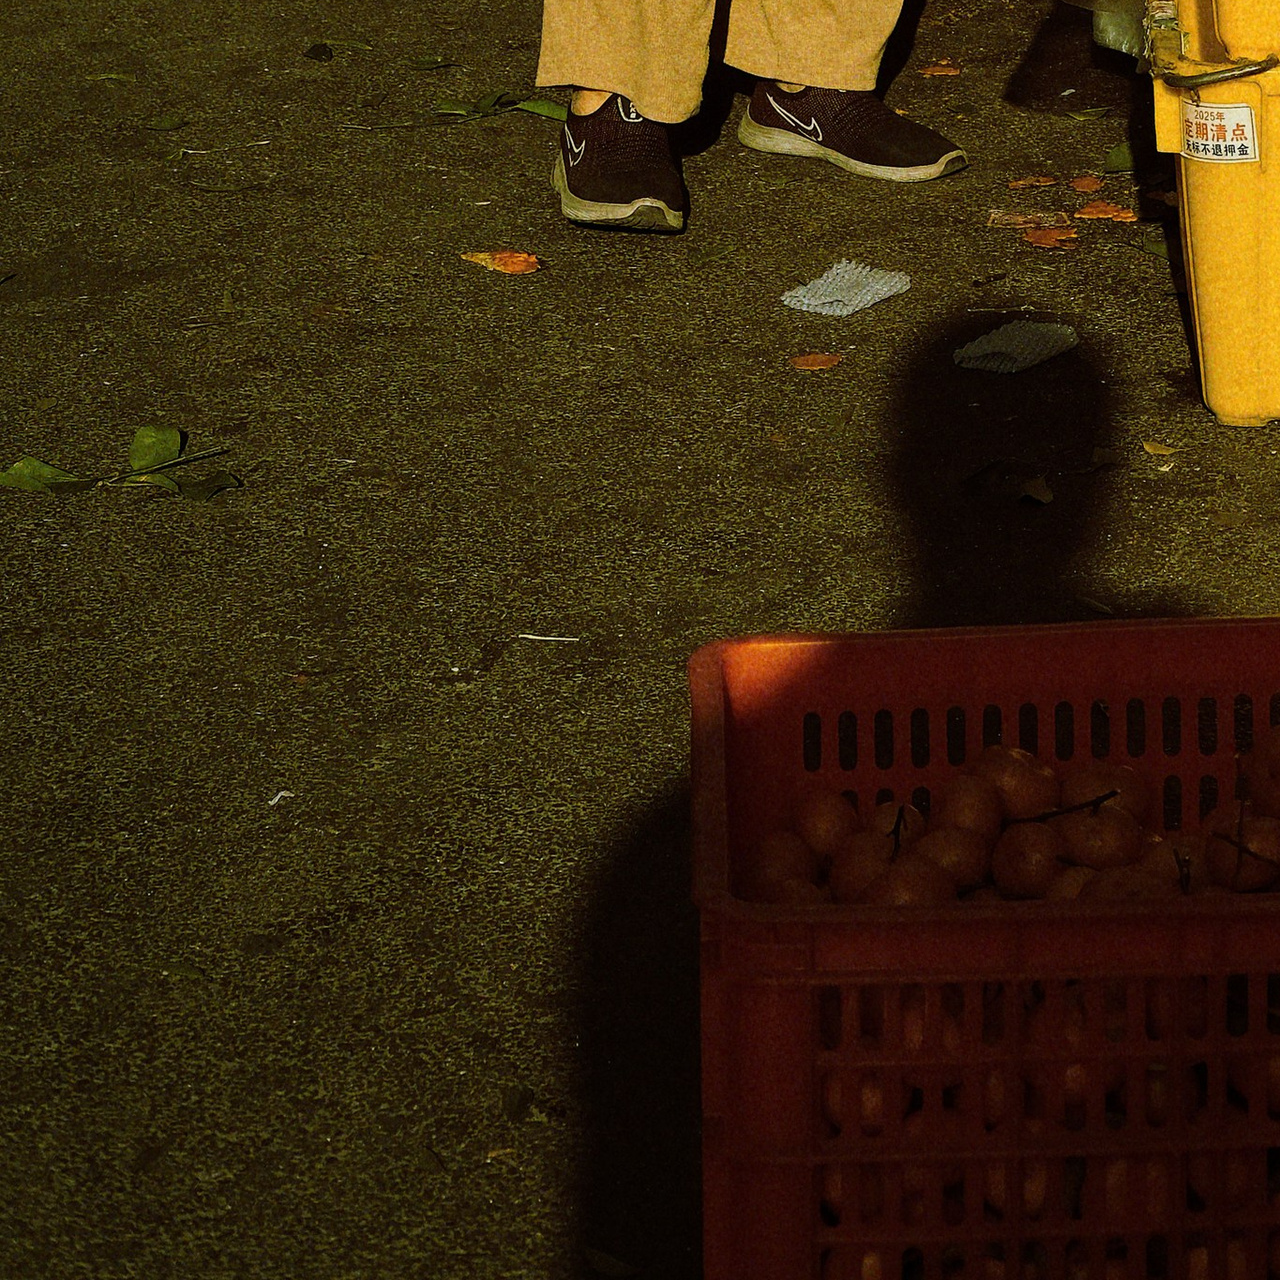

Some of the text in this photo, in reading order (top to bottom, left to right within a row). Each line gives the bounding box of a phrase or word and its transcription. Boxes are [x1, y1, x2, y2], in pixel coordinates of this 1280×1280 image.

[1194, 109, 1226, 123] 2025年
[1184, 118, 1249, 143] 定期清点
[1184, 138, 1250, 157] 无标不退押金
